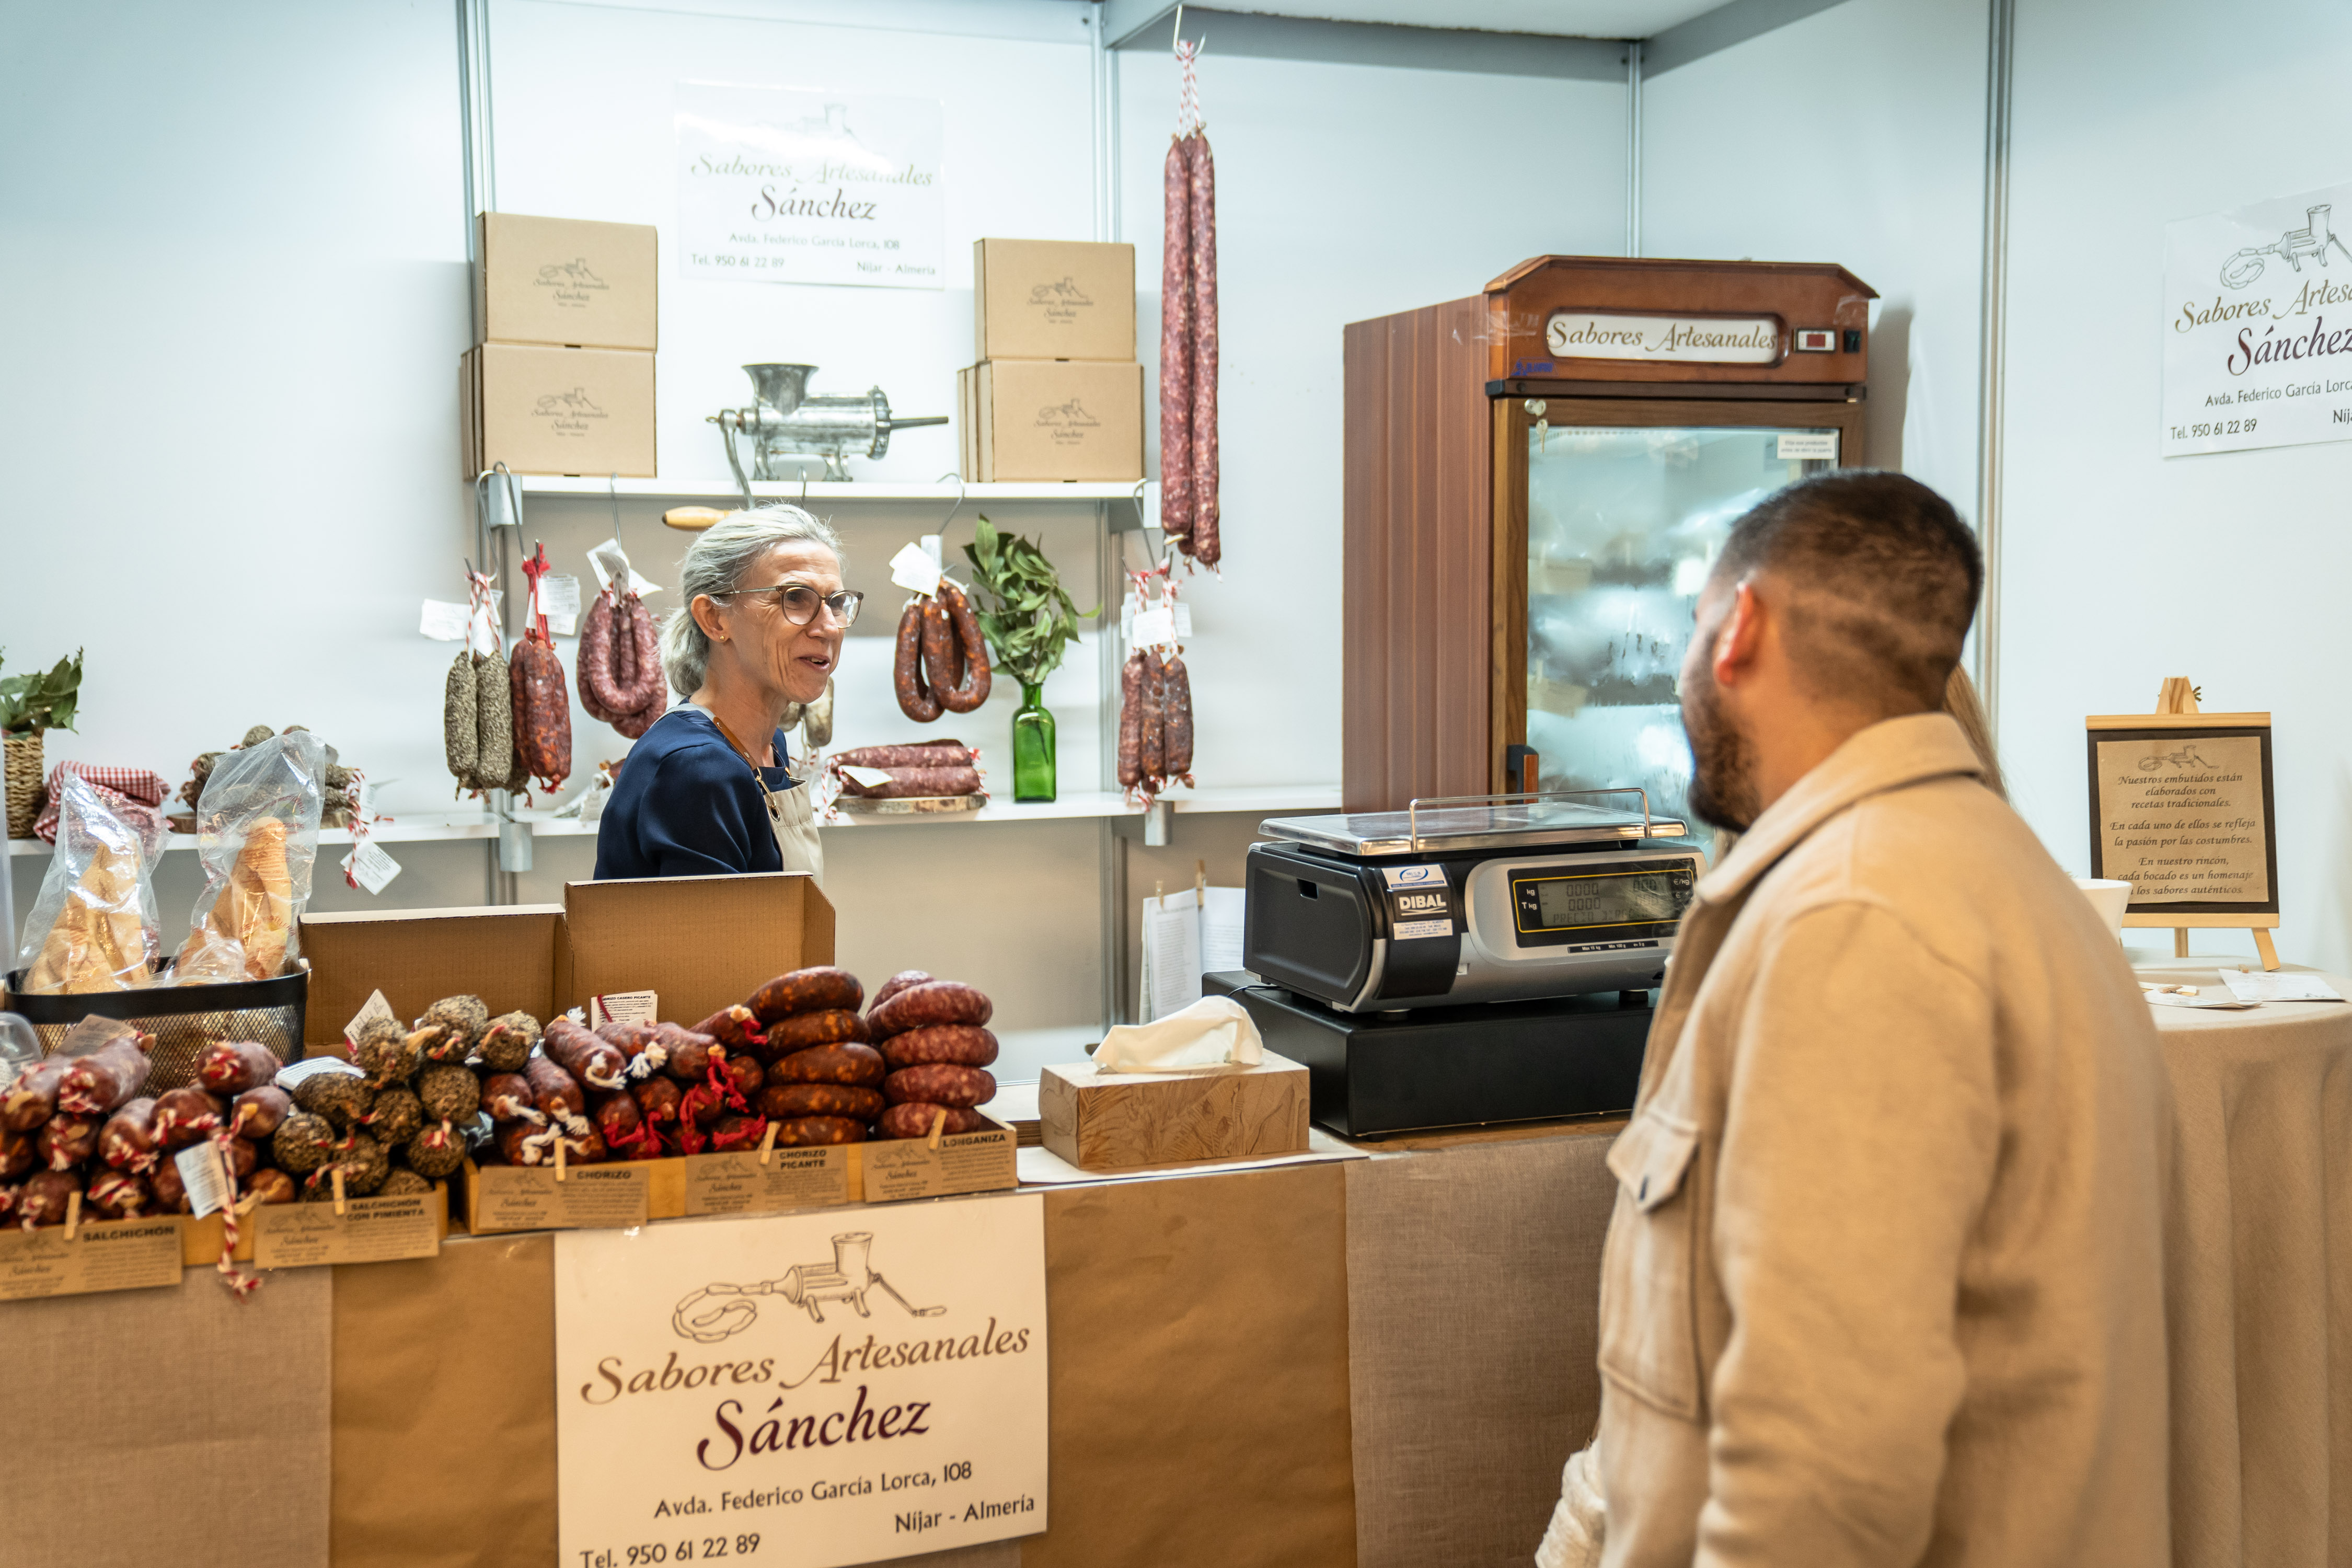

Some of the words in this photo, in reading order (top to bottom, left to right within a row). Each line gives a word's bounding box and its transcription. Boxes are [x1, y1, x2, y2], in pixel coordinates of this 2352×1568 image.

[690, 152, 792, 178] Sabores
[752, 184, 877, 221] Sánchez
[729, 233, 759, 245] Avda.
[764, 233, 808, 246] Federico
[812, 235, 845, 248] García
[849, 237, 880, 250] Lorca,
[883, 239, 900, 250] 108
[691, 253, 710, 266] Tel.
[715, 255, 735, 267] 950
[754, 258, 767, 268] 22
[772, 258, 785, 268] 89
[2174, 296, 2270, 333] Sabores
[1548, 321, 1643, 349] Sabores
[1645, 322, 1777, 352] Artesanales
[2228, 316, 2352, 376] Sánchez
[2205, 393, 2233, 407] Avda.
[2238, 387, 2281, 403] Federico
[2286, 381, 2321, 397] García
[2171, 426, 2187, 440] Tel.
[2192, 424, 2210, 438] 950
[2214, 422, 2223, 435] 61
[2227, 420, 2240, 434] 22
[2244, 418, 2257, 432] 89
[2118, 776, 2162, 785] Nuestros
[2164, 773, 2214, 783] embutidos
[2217, 773, 2243, 782] están
[2146, 786, 2196, 795] elaborados
[2167, 798, 2231, 808] tradicionales.
[2110, 822, 2125, 831] En
[2128, 820, 2150, 830] cada
[2174, 820, 2185, 829] de
[2188, 819, 2209, 829] ellos
[2225, 818, 2255, 831] refleja
[2114, 837, 2123, 846] la
[2126, 837, 2157, 849] pasión
[2160, 839, 2177, 848] por
[2180, 836, 2193, 845] las
[2196, 835, 2252, 844] costumbres.
[2138, 858, 2153, 866] En
[2196, 856, 2229, 866] rincón,
[2118, 870, 2140, 881] cada
[2143, 870, 2176, 880] bocado
[2208, 870, 2254, 881] homenaje
[2137, 885, 2150, 895] los
[2153, 885, 2188, 895] sabores
[2191, 885, 2244, 894] auténticos.
[1399, 894, 1446, 909] DIBAL
[943, 1134, 1006, 1148] LONGANIZA
[779, 1149, 826, 1159] CHORIZO
[780, 1159, 825, 1170] PICANTE
[577, 1170, 631, 1180] CHORIZO
[580, 1352, 775, 1406] Sabores
[779, 1317, 1031, 1389] Artesanales
[697, 1385, 931, 1471] Sánchez
[654, 1495, 712, 1519] Avda.
[721, 1485, 804, 1512] Federico
[811, 1476, 872, 1502] García
[881, 1467, 937, 1492] Lorca,
[943, 1461, 972, 1483] 108
[895, 1508, 942, 1535] Níjar
[964, 1494, 1035, 1523] Almería
[579, 1549, 618, 1568] Tel.
[627, 1543, 667, 1566] 950
[675, 1540, 693, 1561] 61
[702, 1537, 728, 1559] 22
[736, 1532, 760, 1554] 89
